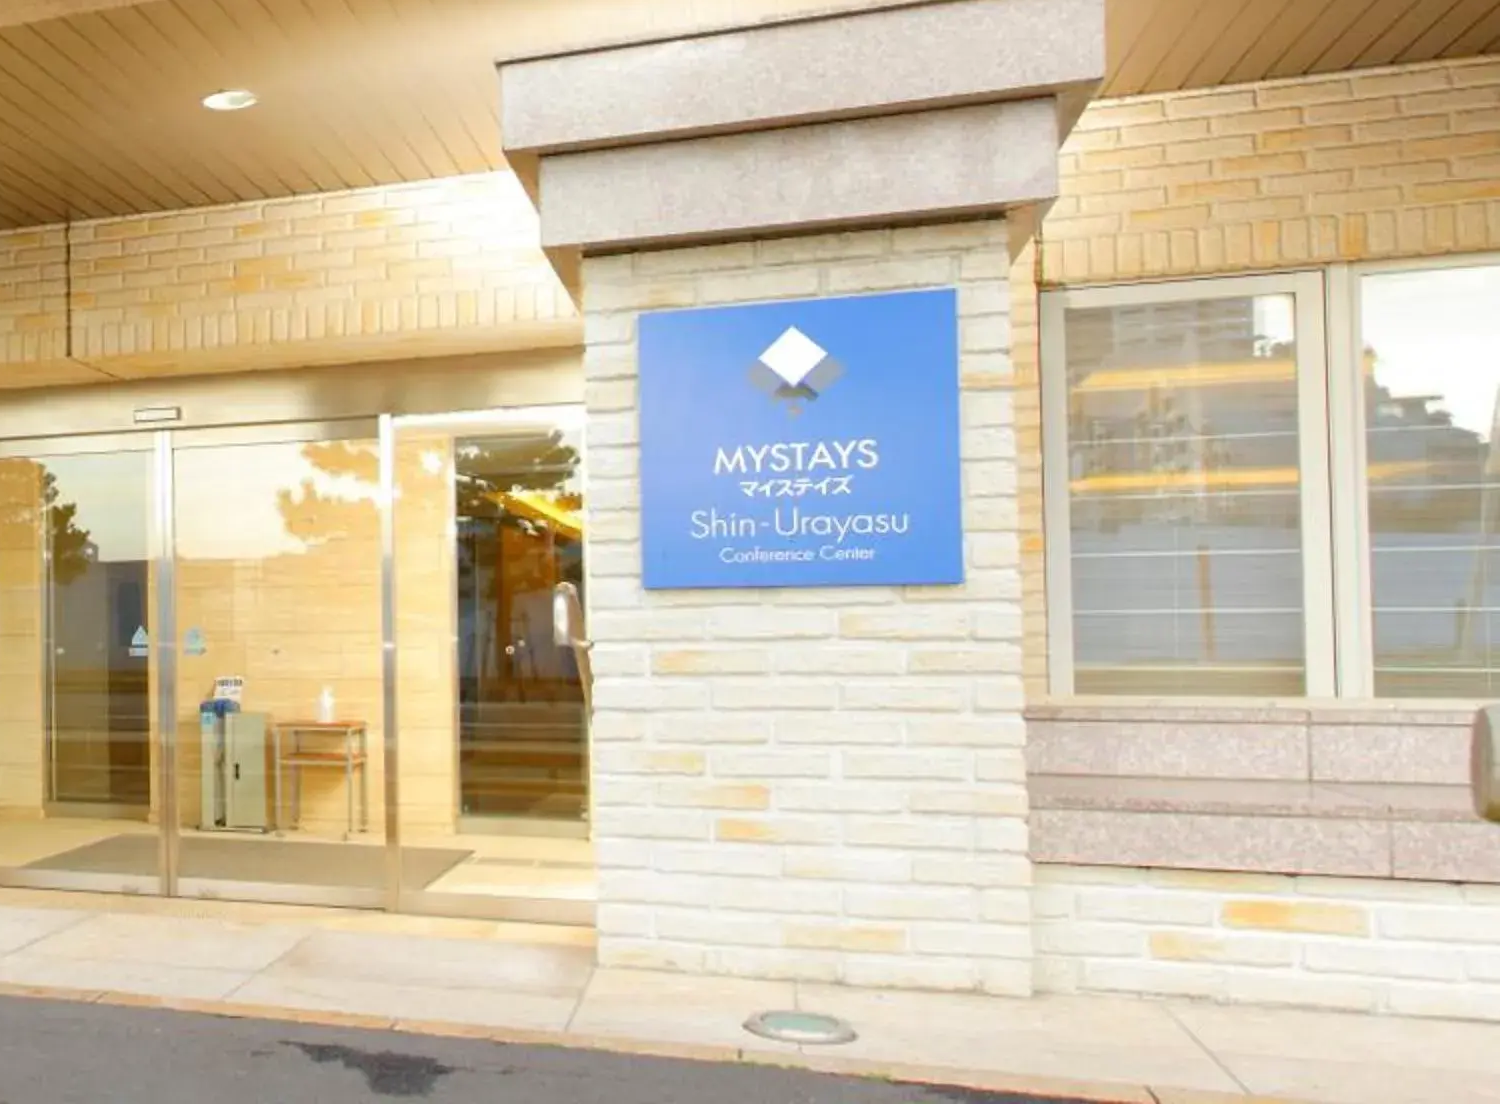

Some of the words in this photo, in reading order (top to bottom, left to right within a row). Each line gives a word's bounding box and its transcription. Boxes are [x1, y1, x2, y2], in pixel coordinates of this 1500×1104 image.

[712, 439, 879, 475] MYSTAYS
[739, 474, 854, 498] マイステイズ
[719, 547, 815, 563] Conference
[819, 545, 875, 561] Center
